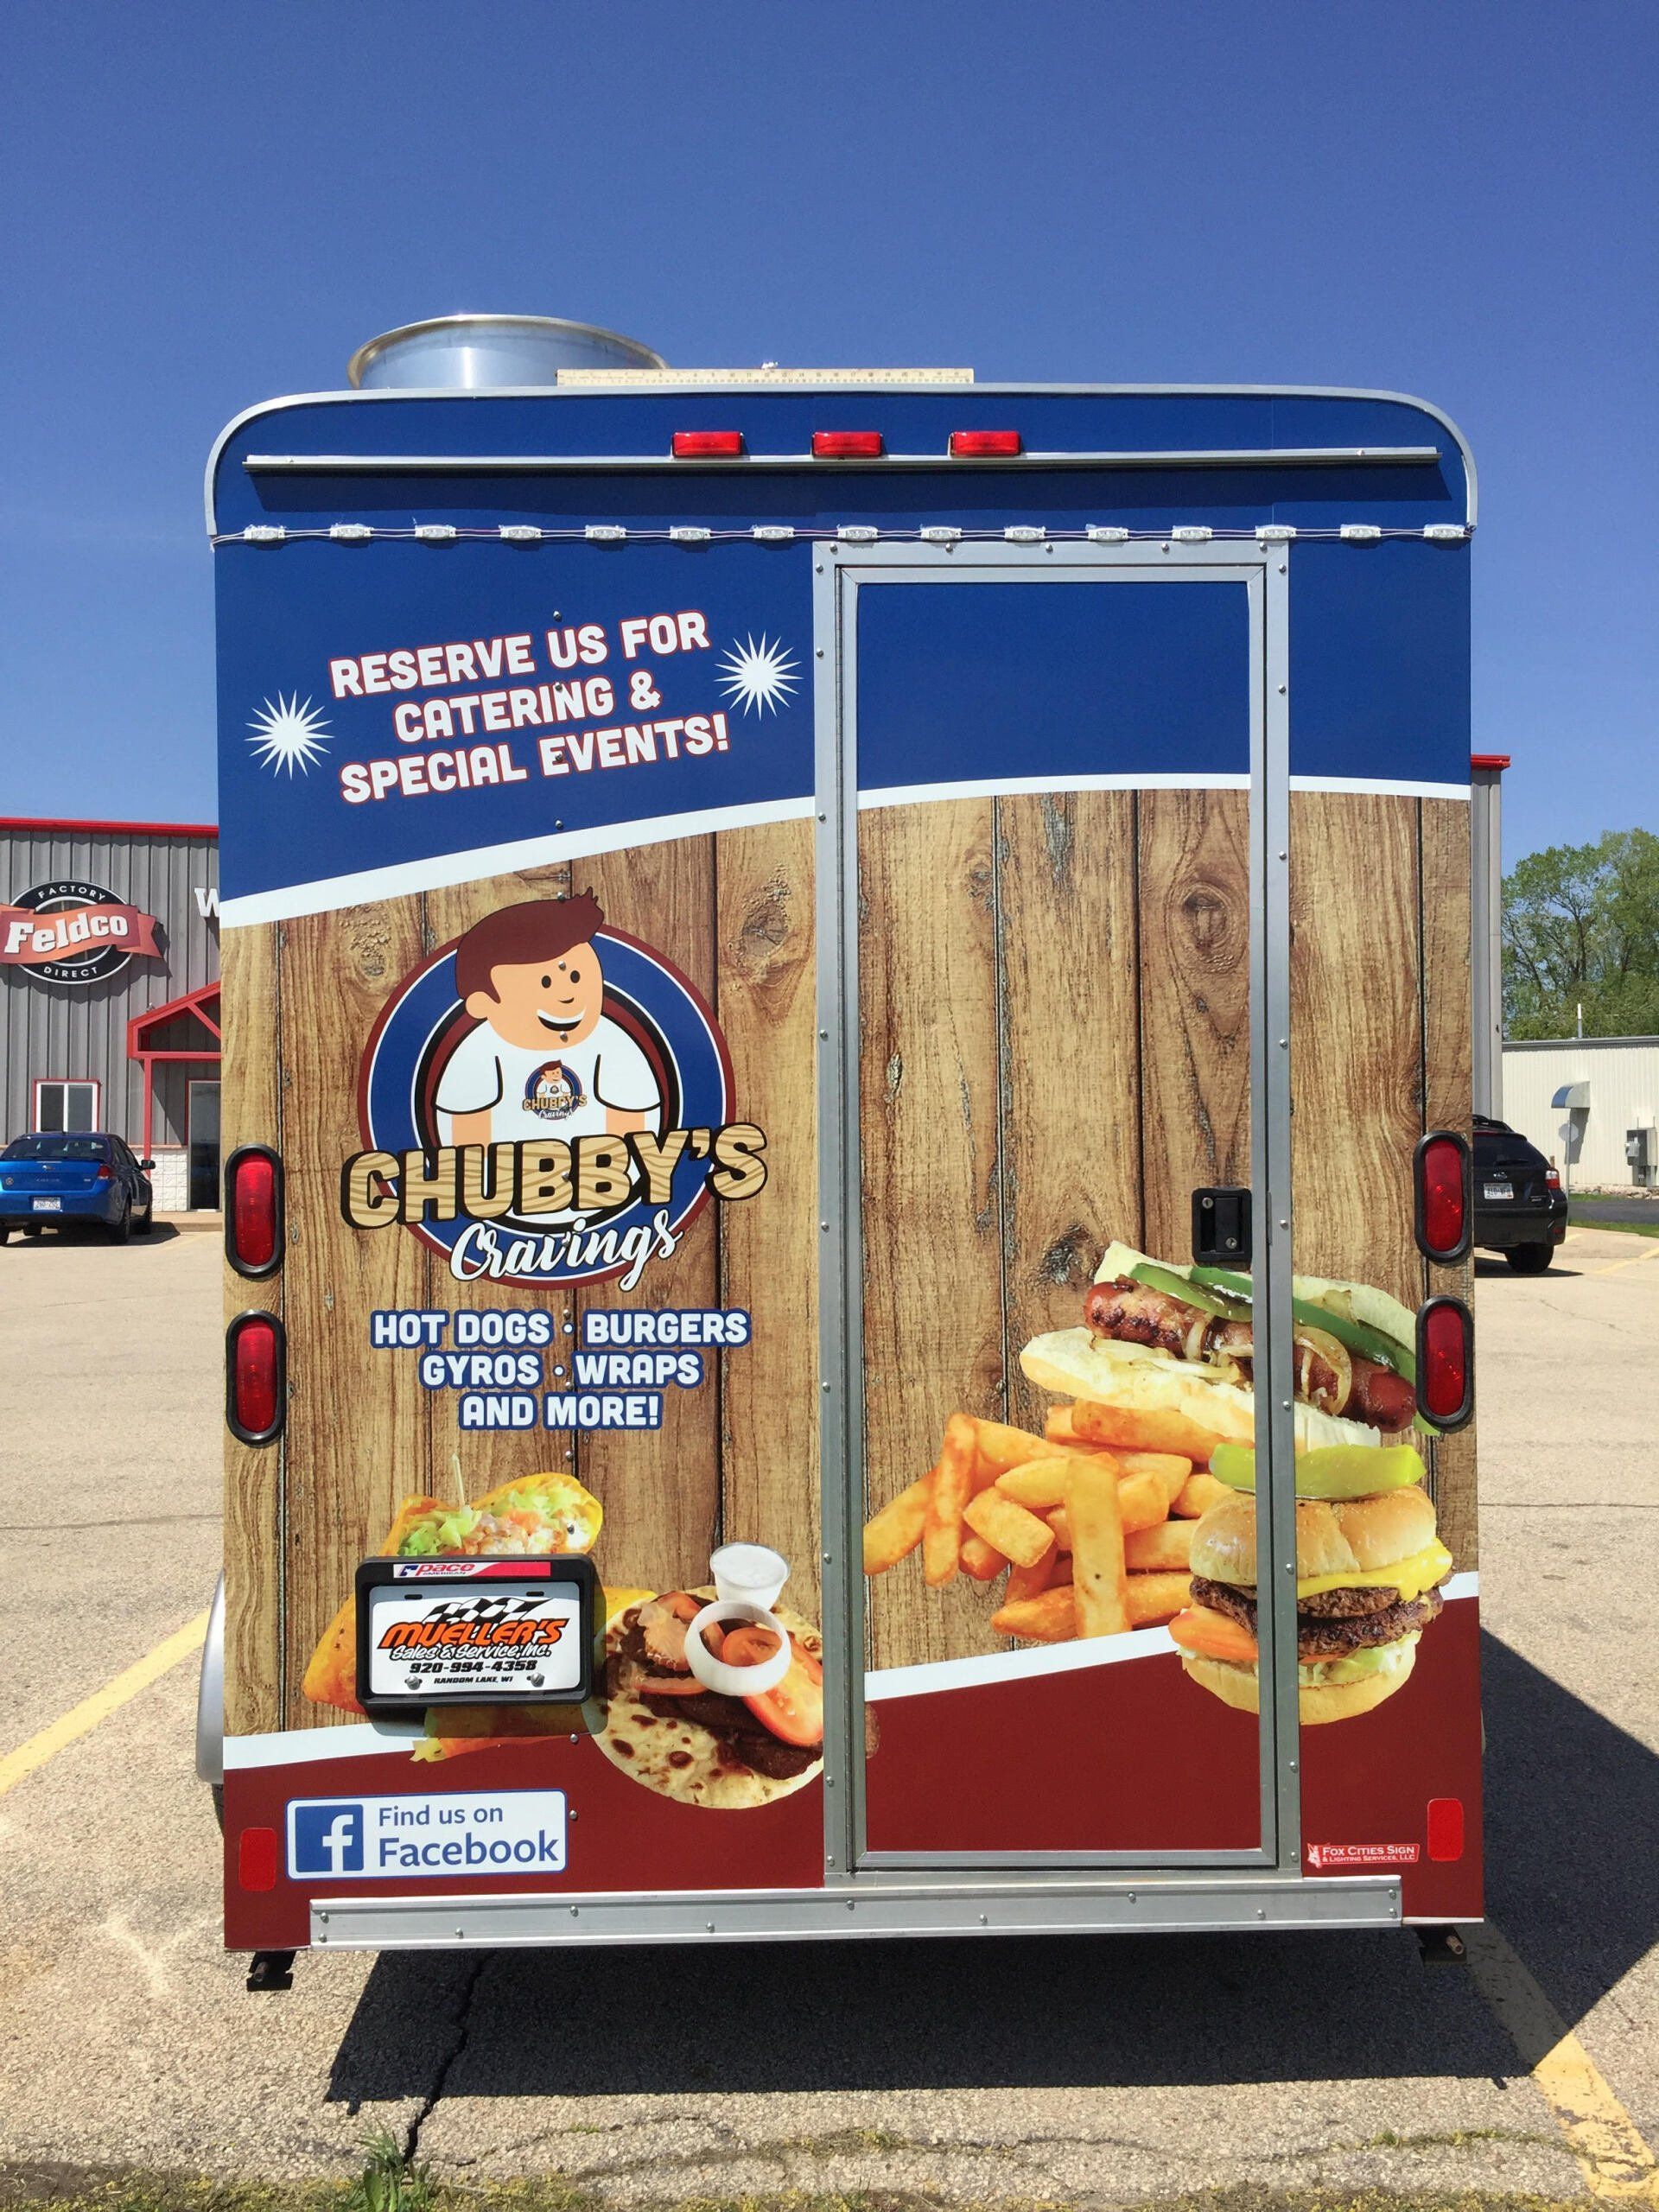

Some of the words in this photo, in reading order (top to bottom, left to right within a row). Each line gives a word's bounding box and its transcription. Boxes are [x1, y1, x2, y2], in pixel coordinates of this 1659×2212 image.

[331, 635, 534, 696] RESERVE
[549, 625, 607, 669] US
[621, 612, 709, 658] FOR
[395, 676, 613, 741] CATERING
[630, 671, 661, 709] &
[341, 744, 527, 804] SPECIAL
[539, 714, 729, 774] EVENTS!
[38, 886, 105, 900] FACTORY
[4, 912, 128, 953] Feldco
[44, 966, 99, 978] DIRECT
[342, 1122, 768, 1229] CHUBBY'S
[450, 1210, 683, 1293] Cravings
[375, 1314, 445, 1344] HOT
[459, 1313, 550, 1344] DOGS
[587, 1312, 747, 1344] BURGERS
[423, 1354, 540, 1384] GYROS
[576, 1353, 701, 1384] WRAPS
[463, 1396, 534, 1426] AND
[548, 1395, 658, 1426] MORE!
[378, 1618, 569, 1649] MUELLER'S
[390, 1644, 439, 1660] Sales
[440, 1644, 455, 1659] &
[410, 1660, 537, 1674] 920-994-4358
[379, 1805, 429, 1827] Find
[439, 1809, 465, 1824] us
[474, 1807, 503, 1823] on
[379, 1830, 559, 1866] Facebook
